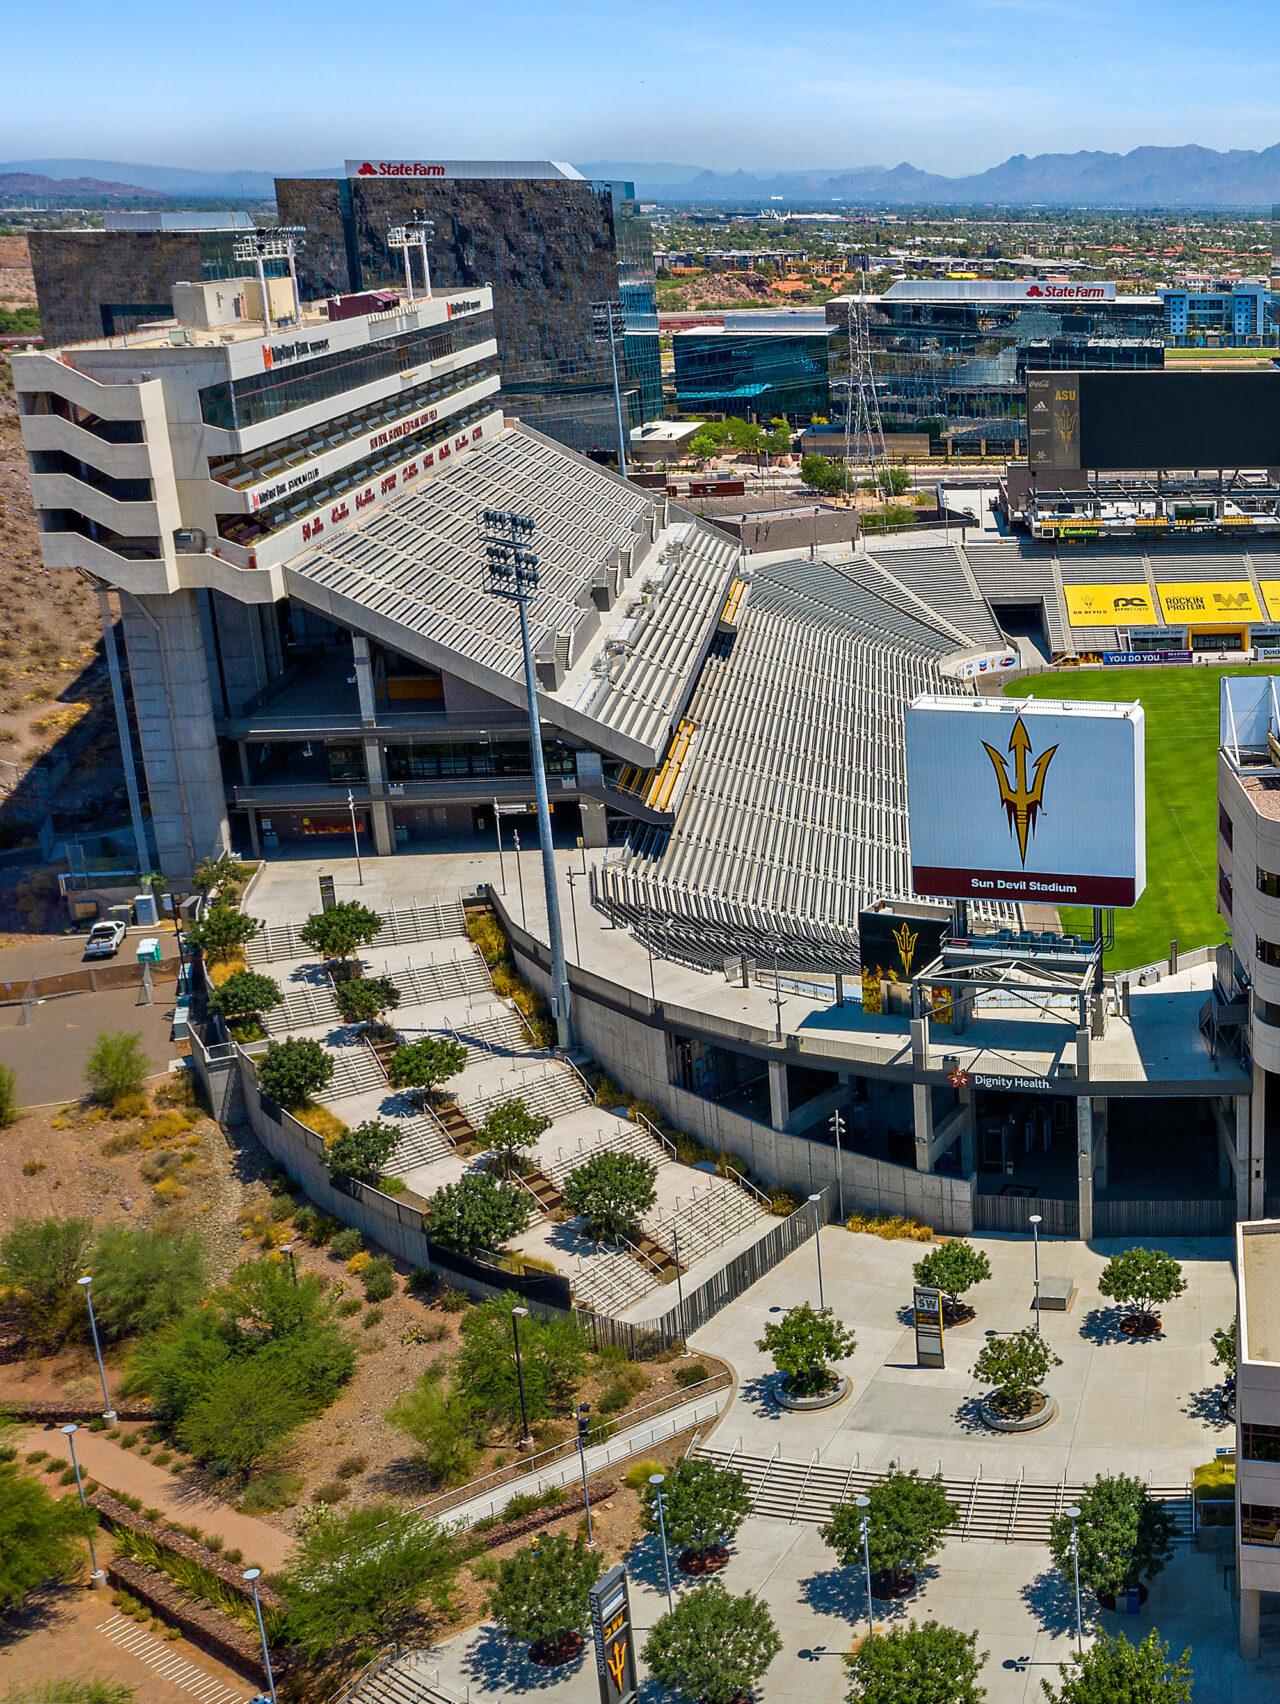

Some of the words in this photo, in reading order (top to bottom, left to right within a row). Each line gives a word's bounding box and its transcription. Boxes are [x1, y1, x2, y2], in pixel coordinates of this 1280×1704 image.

[1055, 390, 1076, 401] ASU
[971, 879, 994, 888] Sun
[997, 880, 1026, 890] Devil
[1029, 881, 1077, 893] Stadium
[974, 1075, 1012, 1088] Dignity
[918, 1299, 936, 1309] SW
[590, 1594, 600, 1622] PLAZA
[604, 1611, 623, 1640] SW
[595, 1624, 606, 1676] SOUTHWEST
